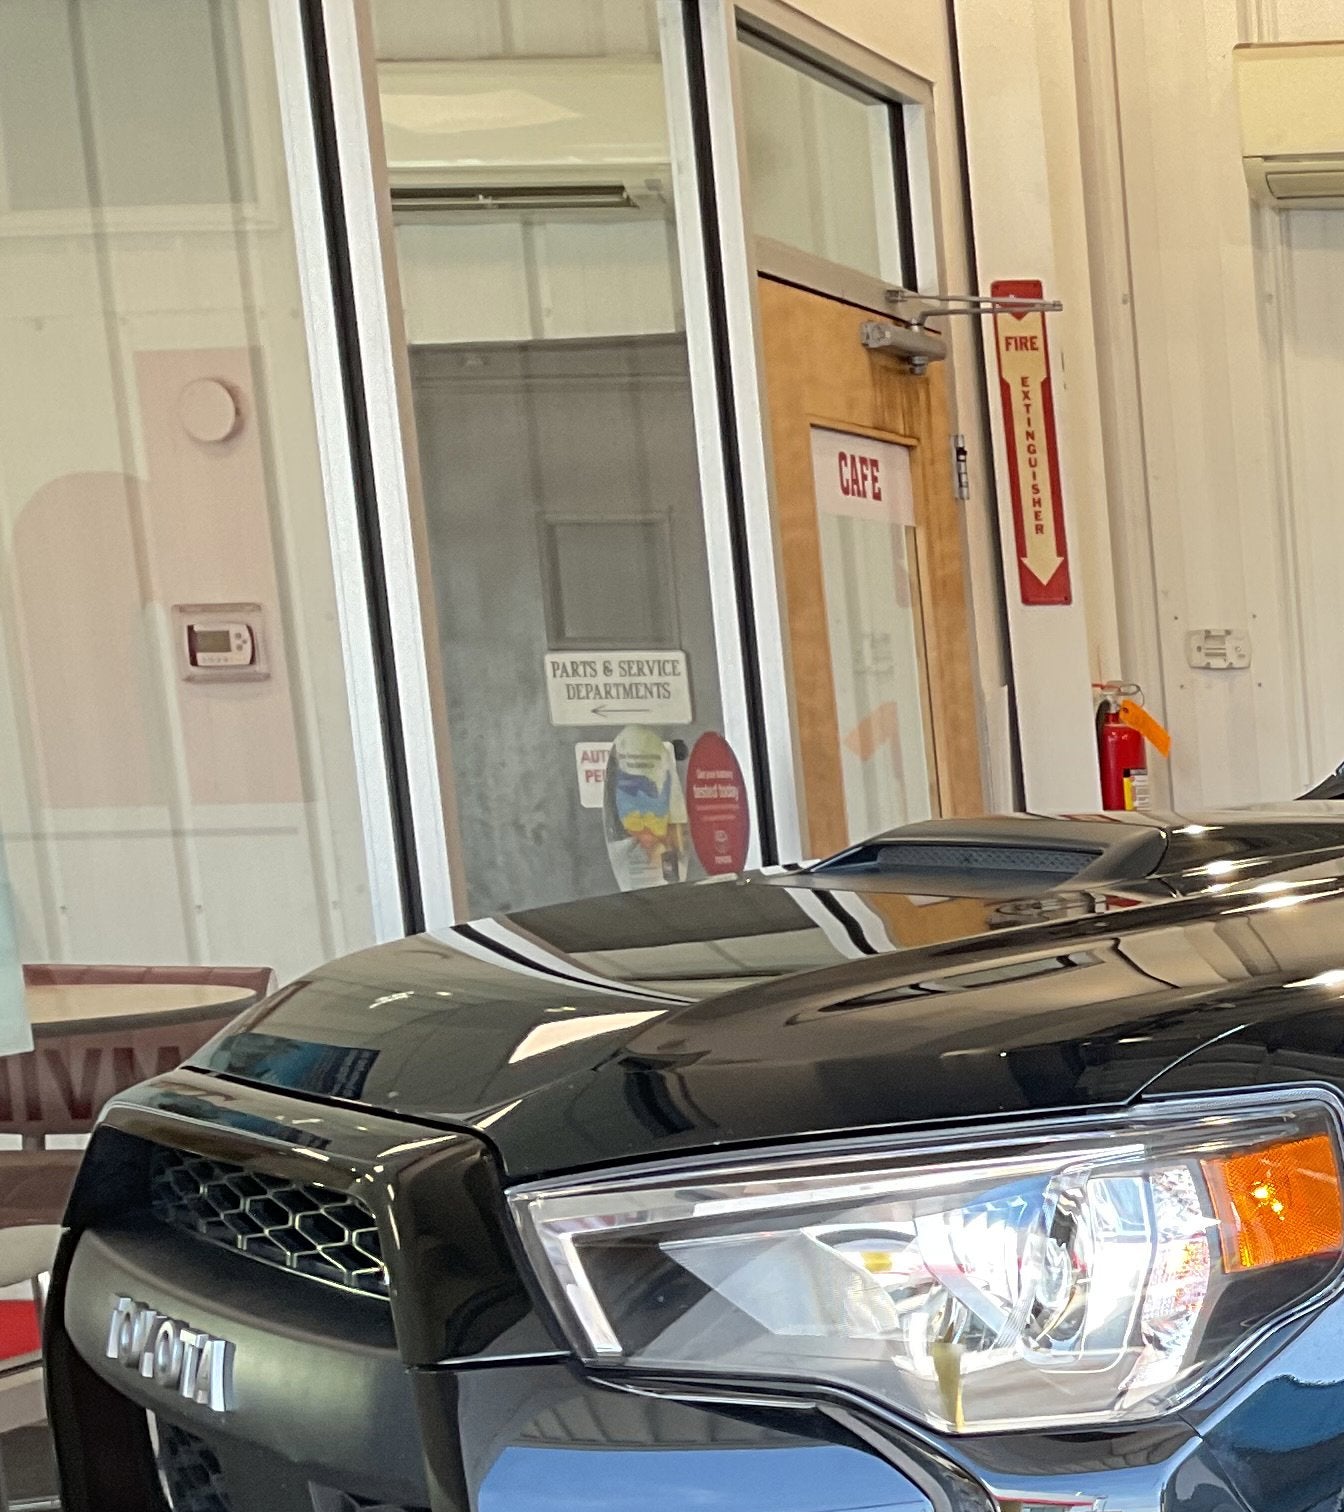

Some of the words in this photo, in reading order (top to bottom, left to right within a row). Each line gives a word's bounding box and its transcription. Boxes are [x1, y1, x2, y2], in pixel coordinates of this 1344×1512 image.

[1004, 336, 1039, 352] FIRE
[1019, 375, 1045, 536] EXTINGUISHER
[837, 451, 882, 502] CAFE
[550, 661, 598, 678] PARTS
[602, 660, 613, 677] &
[618, 659, 681, 677] SERVICE
[565, 681, 671, 700] DEPARTMENTS
